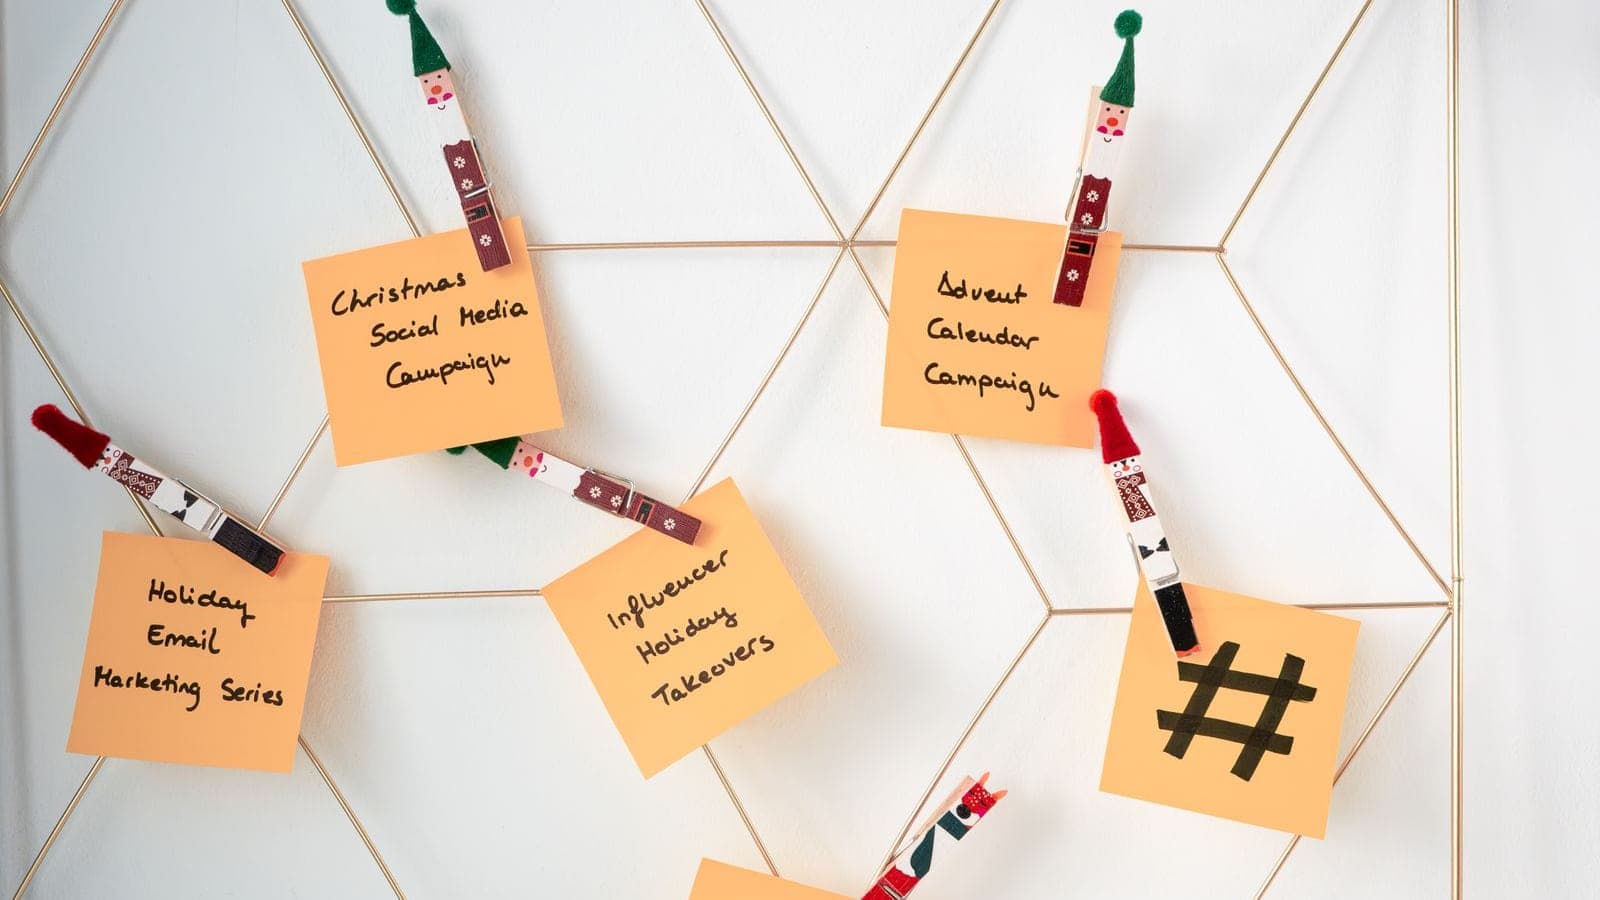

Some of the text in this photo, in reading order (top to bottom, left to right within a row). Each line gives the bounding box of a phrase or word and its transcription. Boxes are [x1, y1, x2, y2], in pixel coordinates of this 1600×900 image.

[331, 272, 467, 316] Christmas
[937, 270, 1028, 305] Advent
[370, 299, 529, 348] Social Media
[927, 317, 1040, 350] Calendar
[386, 353, 511, 389] Campaign
[924, 362, 1060, 412] Campaign
[148, 578, 256, 629] Holiday
[607, 549, 729, 630] Influencer
[147, 624, 221, 655] Email
[635, 607, 738, 665] Holiday
[94, 665, 284, 712] Marketing Series
[650, 634, 775, 706] Takeovers
